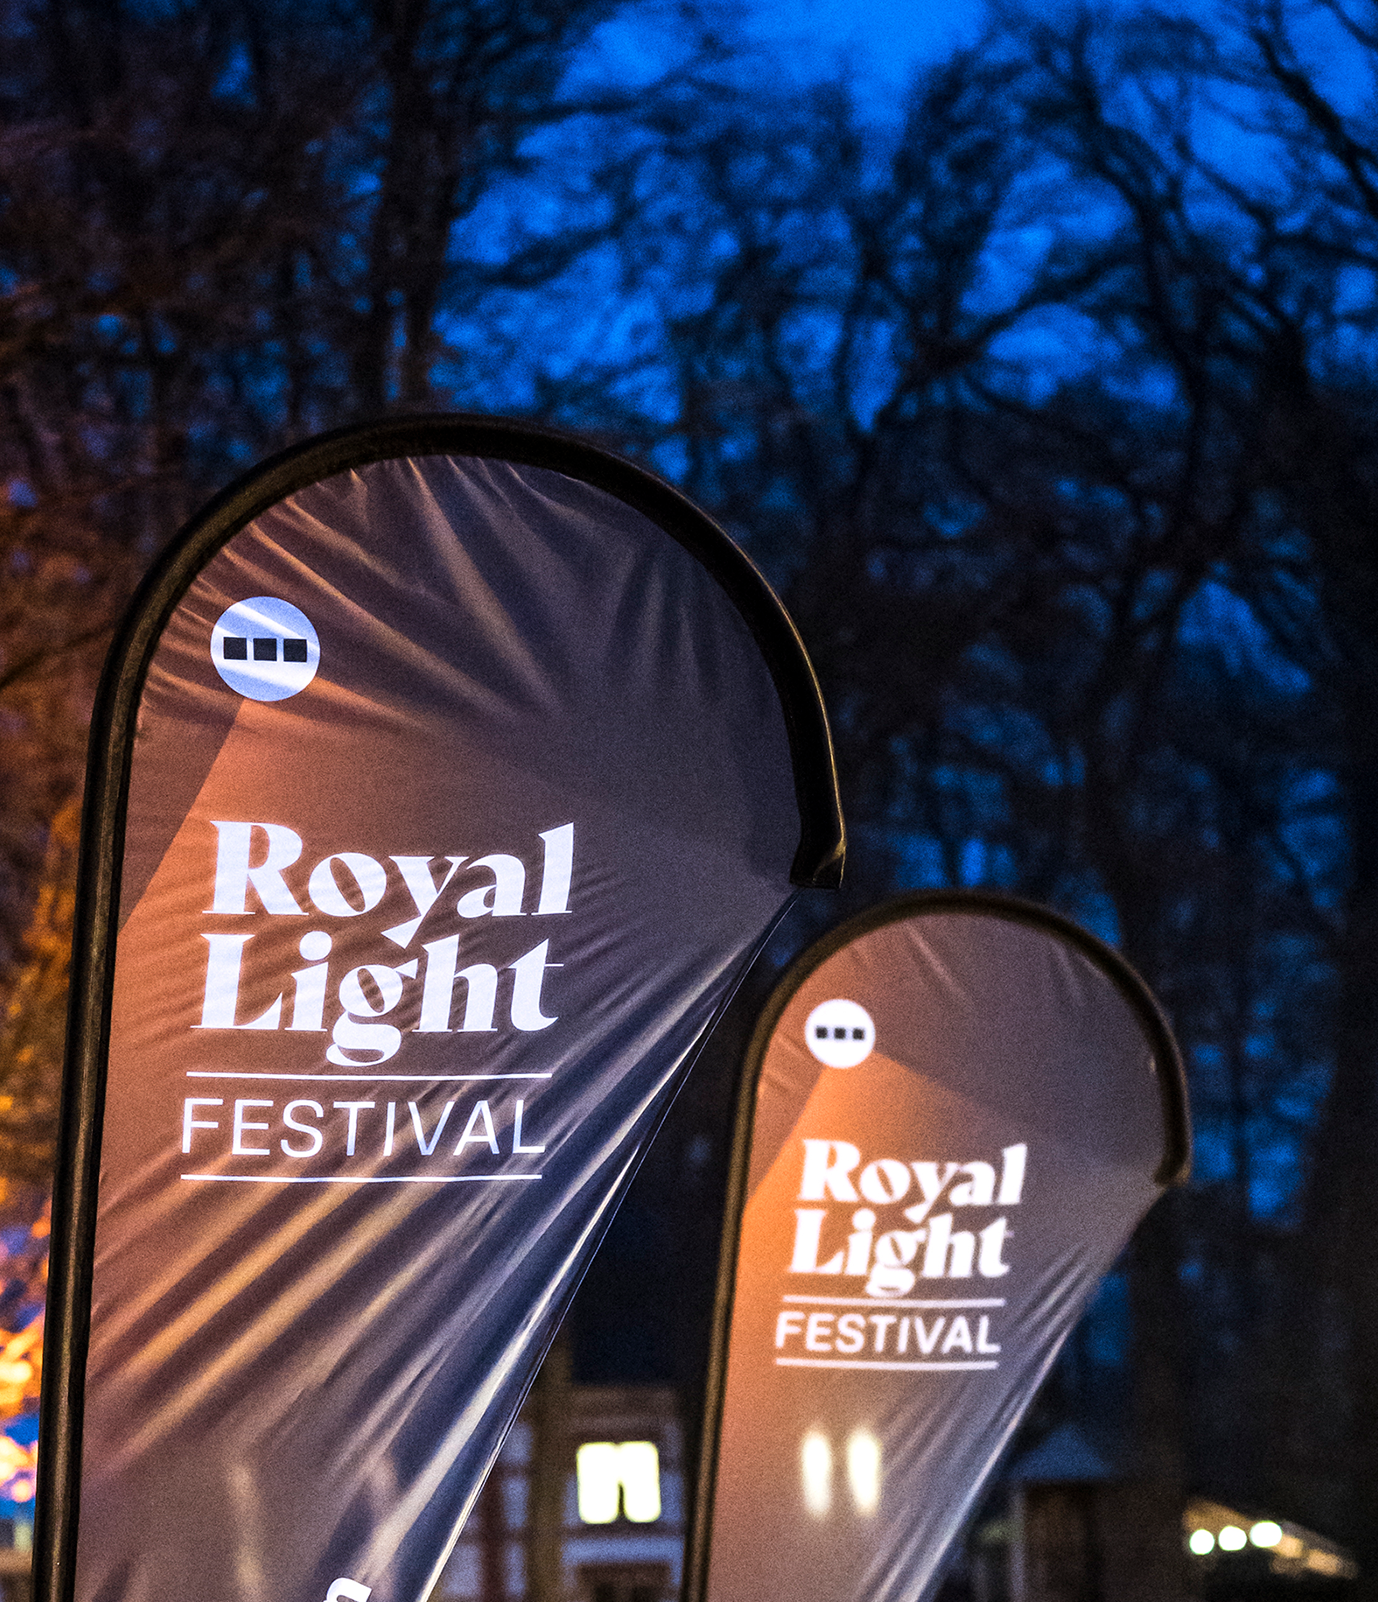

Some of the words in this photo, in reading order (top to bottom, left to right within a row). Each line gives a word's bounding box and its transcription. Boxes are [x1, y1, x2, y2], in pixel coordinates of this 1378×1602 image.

[203, 819, 575, 949] Royal
[190, 931, 565, 1067] Light
[181, 1097, 546, 1158] FESTIVAL
[795, 1138, 1027, 1223] Royal
[788, 1209, 1013, 1298] Light
[775, 1310, 1001, 1356] FESTIVAL
